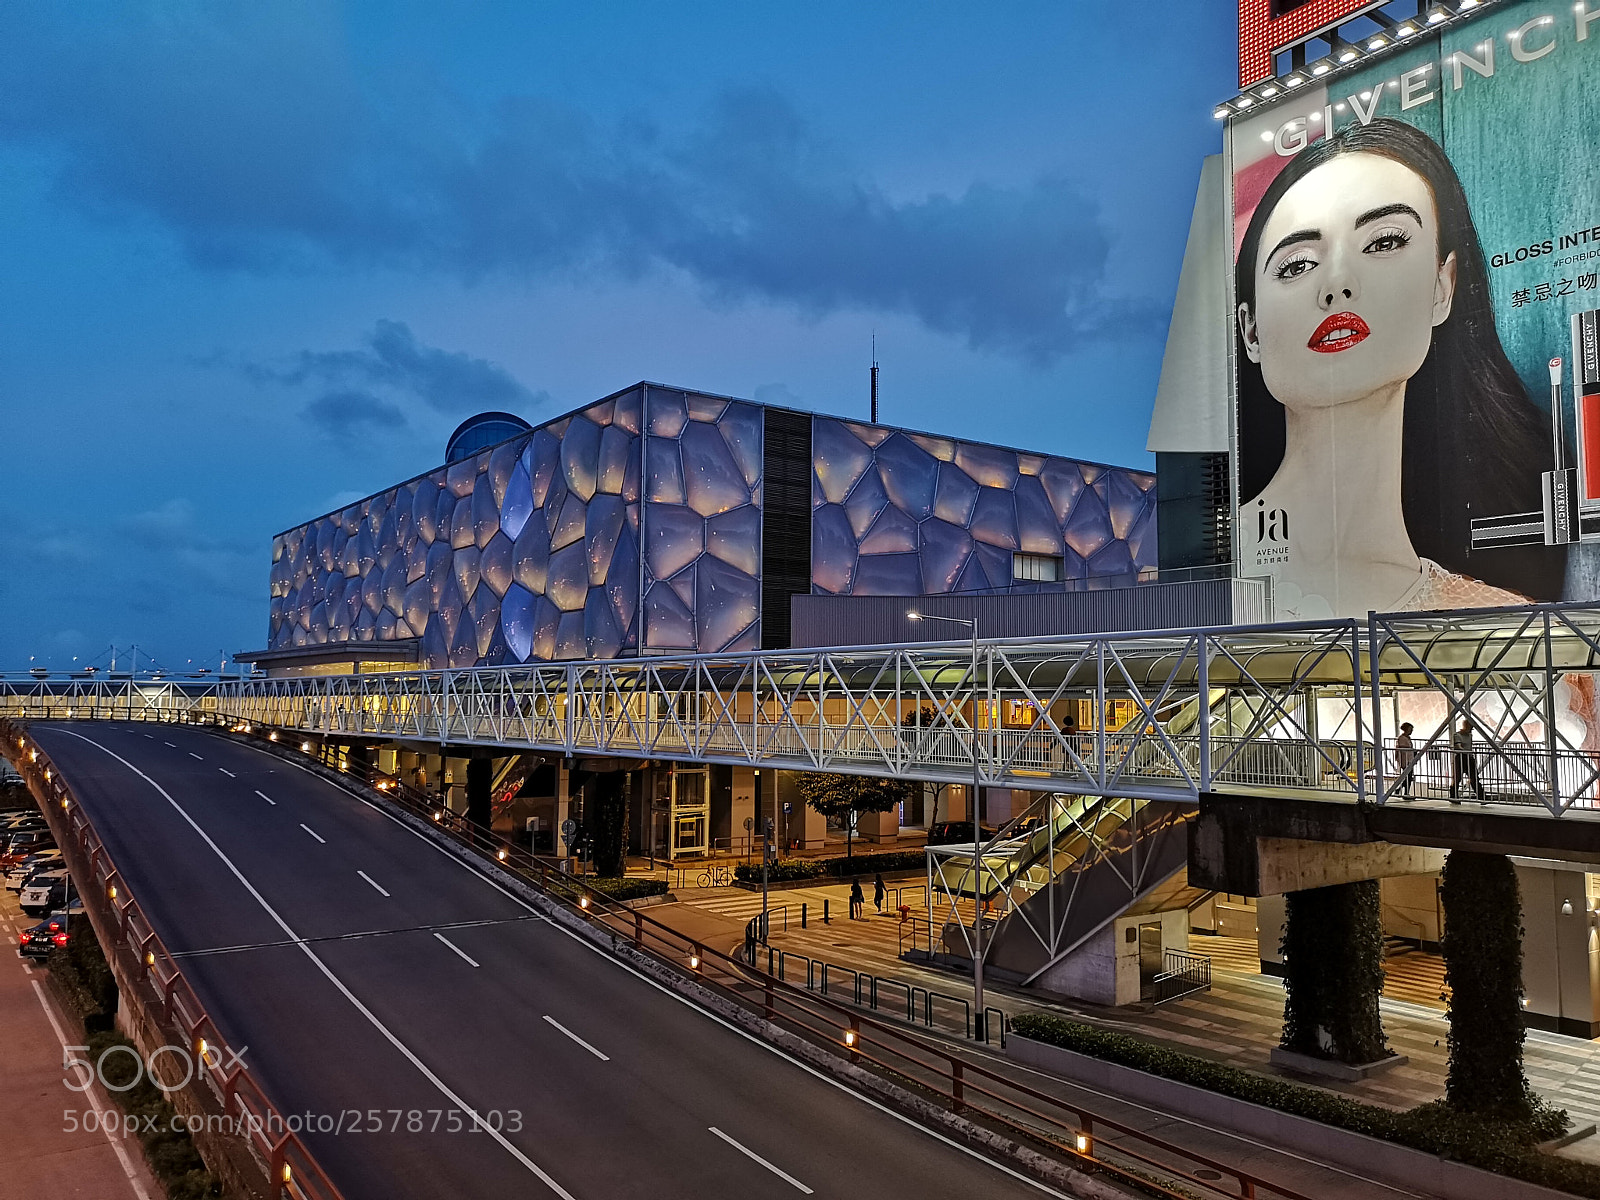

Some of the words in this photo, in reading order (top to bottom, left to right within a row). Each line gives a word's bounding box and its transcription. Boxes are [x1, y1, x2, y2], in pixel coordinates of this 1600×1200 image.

[1490, 240, 1554, 268] GLOSS
[1559, 226, 1600, 250] INTE
[1511, 271, 1598, 309] 禁忌之吻
[1585, 323, 1596, 370] GIVENCHY
[1557, 483, 1567, 531] GIVENCHY
[1256, 546, 1289, 557] AVENUE
